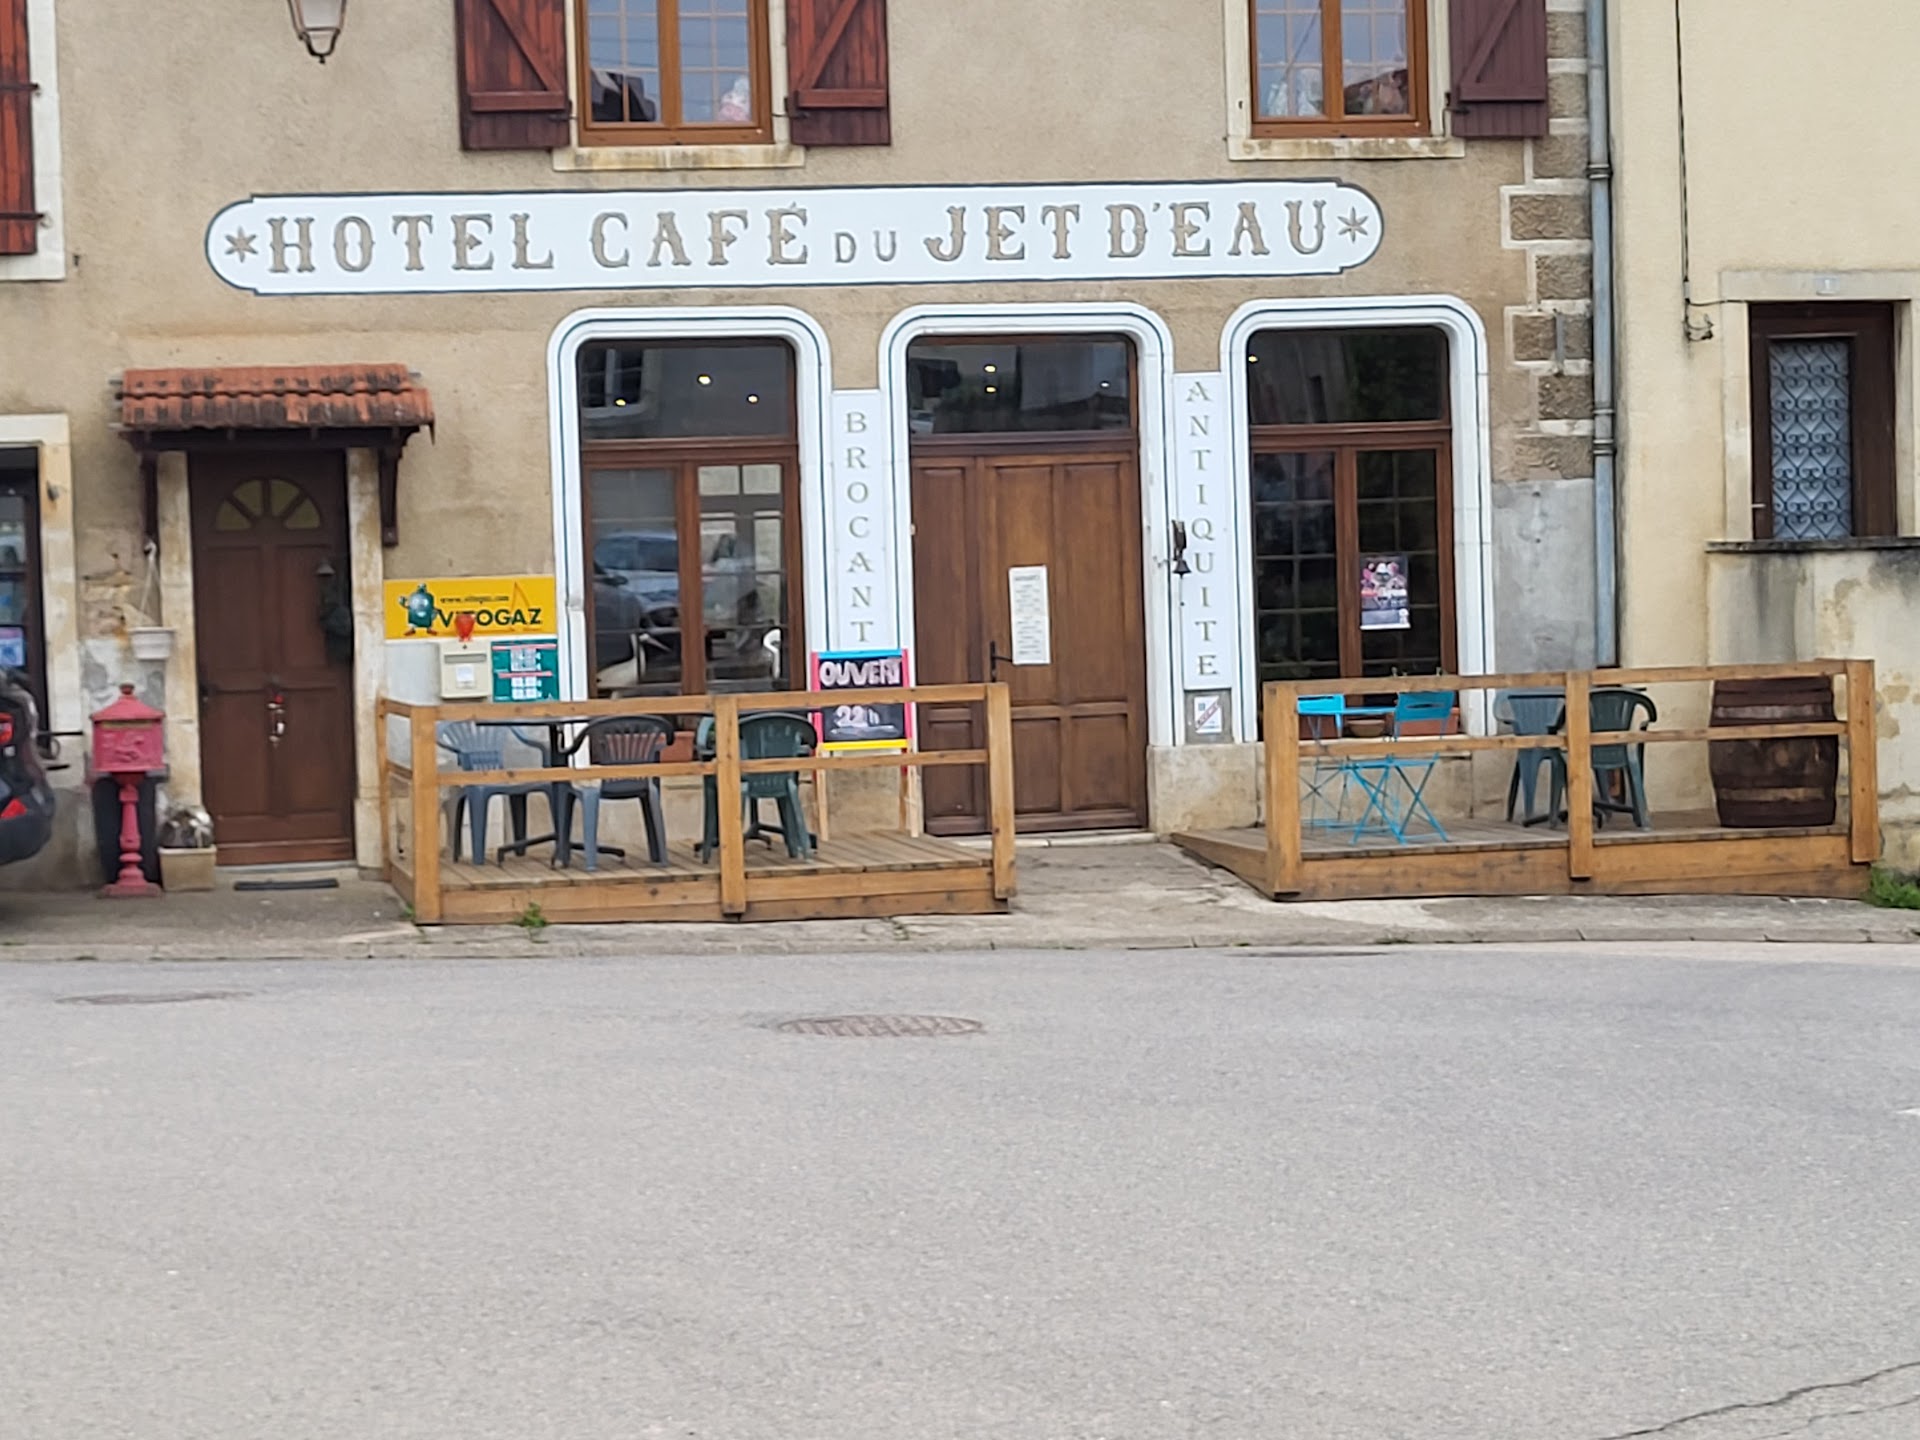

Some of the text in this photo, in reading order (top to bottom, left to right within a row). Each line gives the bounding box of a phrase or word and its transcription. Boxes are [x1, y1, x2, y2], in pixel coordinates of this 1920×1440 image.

[267, 200, 1327, 273] HOTEL CAFÉ DU JET D'EAU
[846, 411, 874, 643] BROCANT
[1186, 381, 1220, 677] ANTIQUITE
[436, 608, 542, 628] VOGAZ
[819, 657, 902, 687] OUVERT
